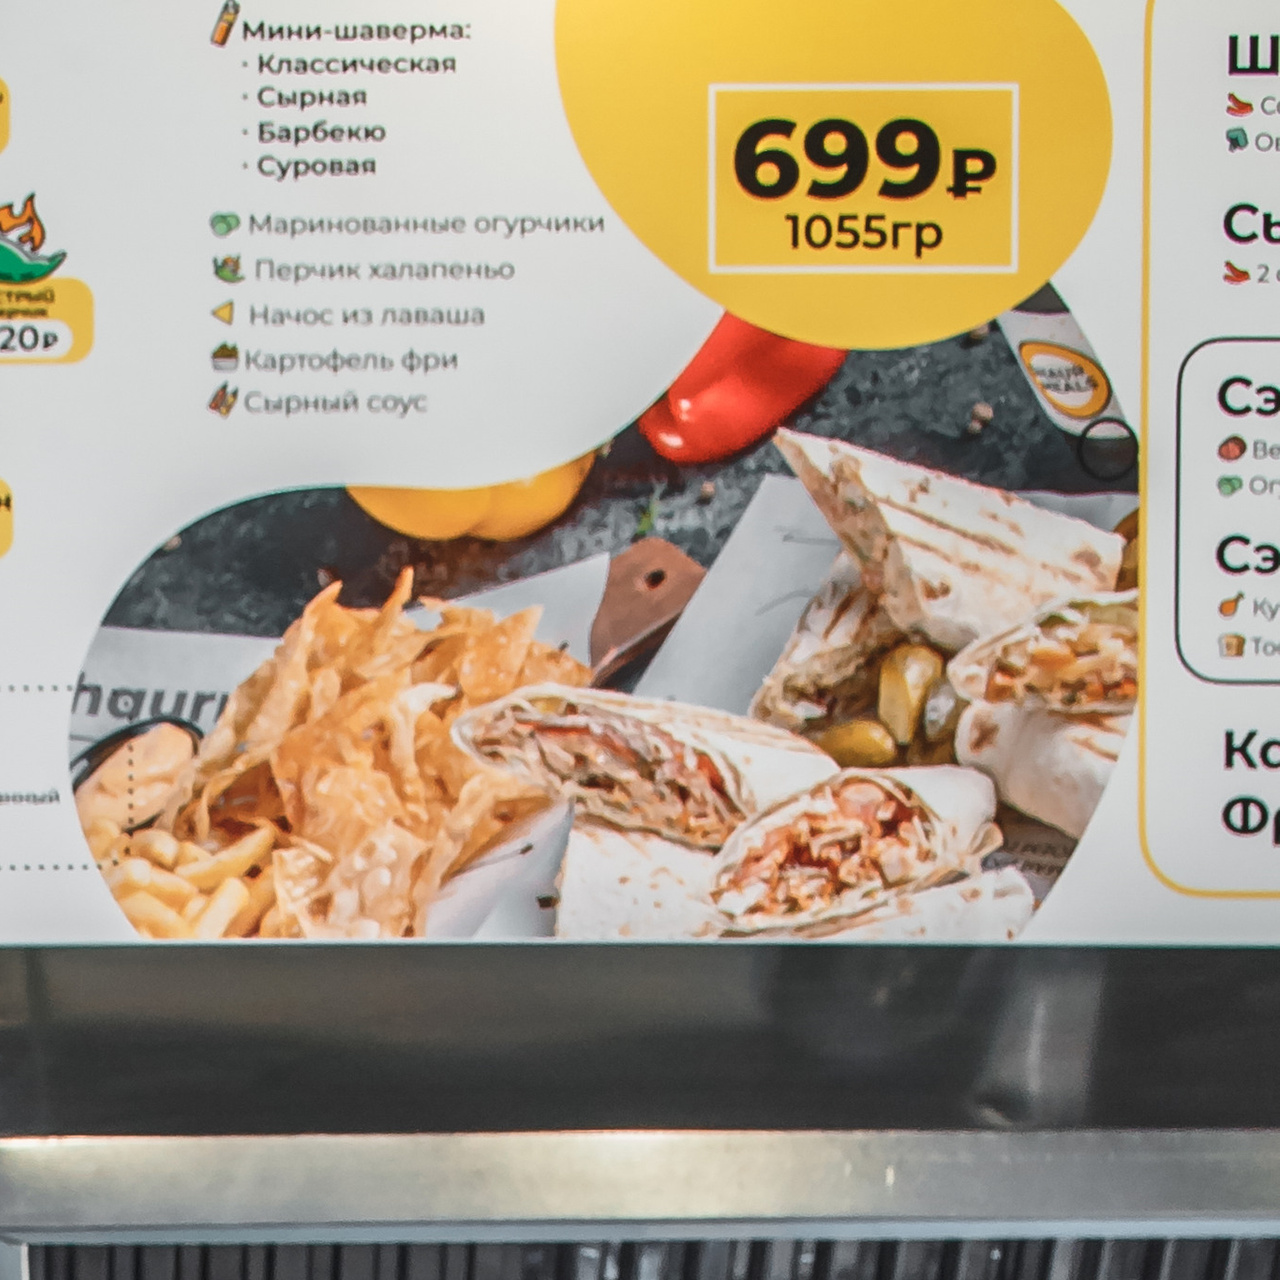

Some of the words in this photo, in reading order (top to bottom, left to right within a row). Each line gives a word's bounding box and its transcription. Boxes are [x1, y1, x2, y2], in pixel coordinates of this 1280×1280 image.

[242, 20, 470, 45] Мини-шаверма:
[258, 53, 456, 75] Классическая
[256, 86, 367, 112] Сырная
[1260, 95, 1280, 116] С
[258, 119, 387, 148] Барбекю
[257, 154, 376, 182] Суровая
[733, 117, 997, 201] 699₽
[248, 213, 467, 239] Маринованные
[474, 216, 605, 239] огурчики
[784, 213, 944, 259] 1055гр
[255, 258, 361, 285] Перчик
[369, 262, 516, 281] халапеньо
[249, 304, 332, 326] Начос
[342, 309, 373, 325] из
[381, 307, 486, 326] лаваша
[244, 348, 395, 376] Картофель
[400, 348, 458, 375] фри
[243, 391, 360, 416] Сырный
[366, 394, 427, 419] соус
[1221, 796, 1280, 846] Ф
